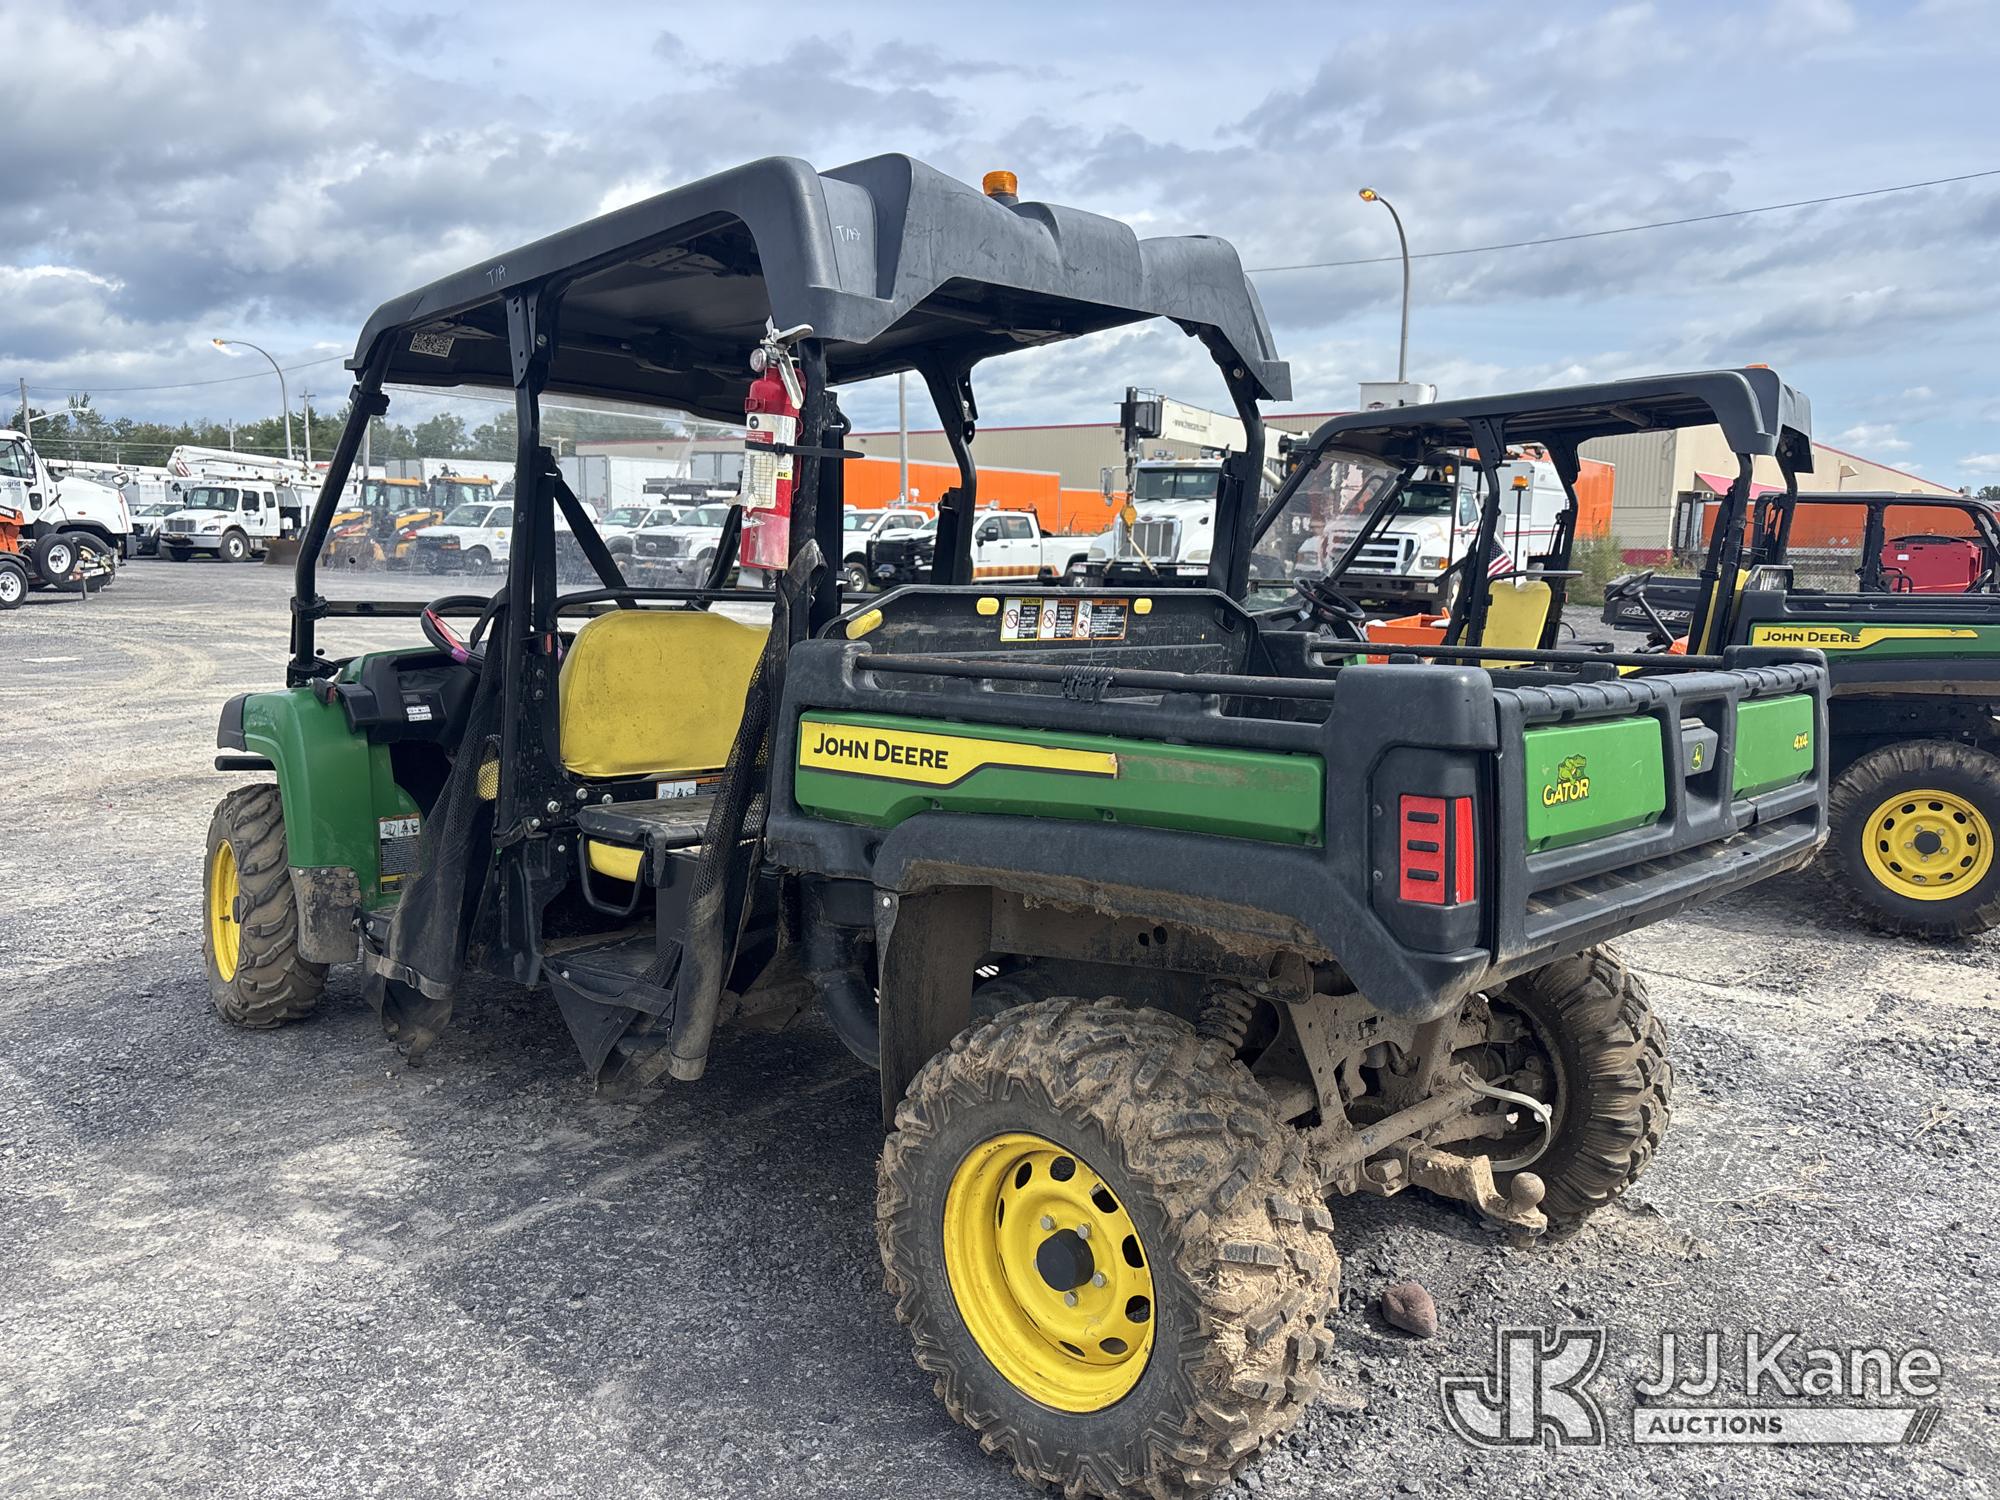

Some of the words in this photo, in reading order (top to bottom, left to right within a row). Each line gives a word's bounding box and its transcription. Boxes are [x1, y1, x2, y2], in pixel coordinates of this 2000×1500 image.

[1762, 631, 1804, 642] JOHN
[1807, 631, 1861, 643] DEERE
[813, 732, 869, 759] JOHN
[874, 739, 949, 769] DEERE
[1542, 777, 1591, 808] GATOR
